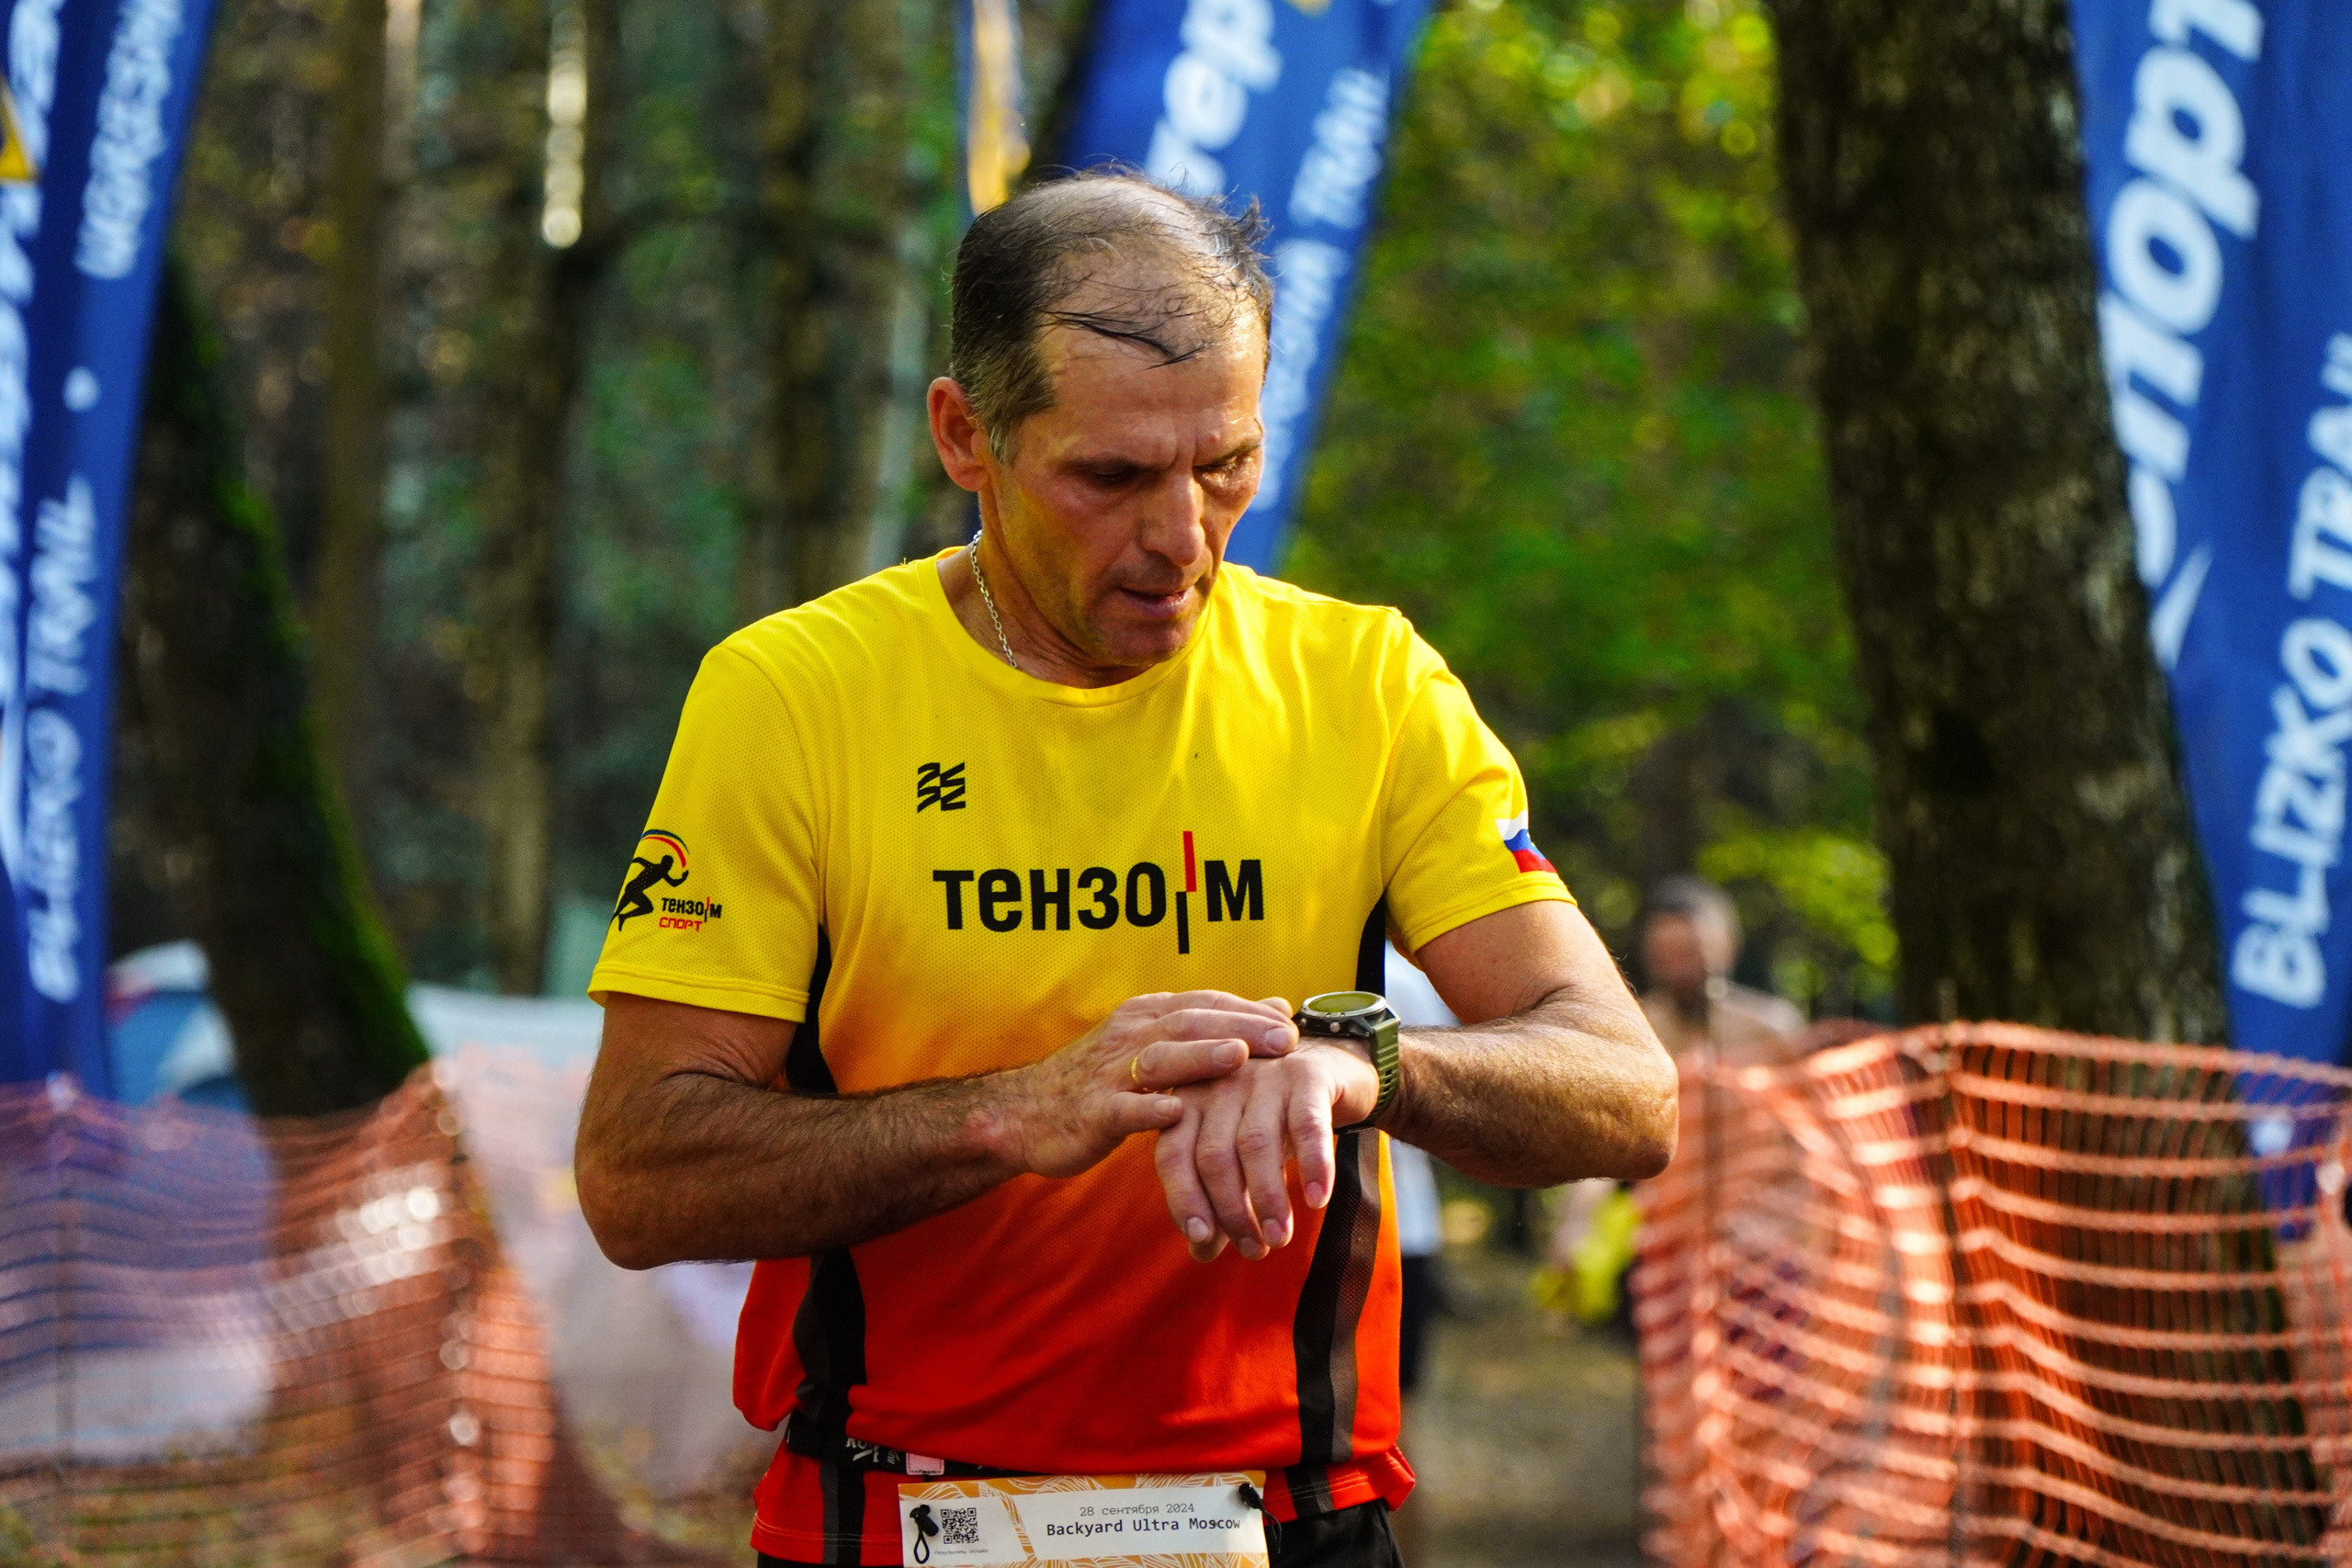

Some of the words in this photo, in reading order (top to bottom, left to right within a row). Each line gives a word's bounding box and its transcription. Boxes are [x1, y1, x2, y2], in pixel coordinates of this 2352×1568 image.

[2231, 617, 2352, 1009] BLIZKO
[1080, 1506, 1094, 1517] 28
[1102, 1505, 1159, 1517] сентября
[1166, 1503, 1195, 1514] 2024
[1046, 1519, 1124, 1538] Backyard
[1133, 1517, 1180, 1532] Ultra
[1189, 1517, 1240, 1530] Moscow
